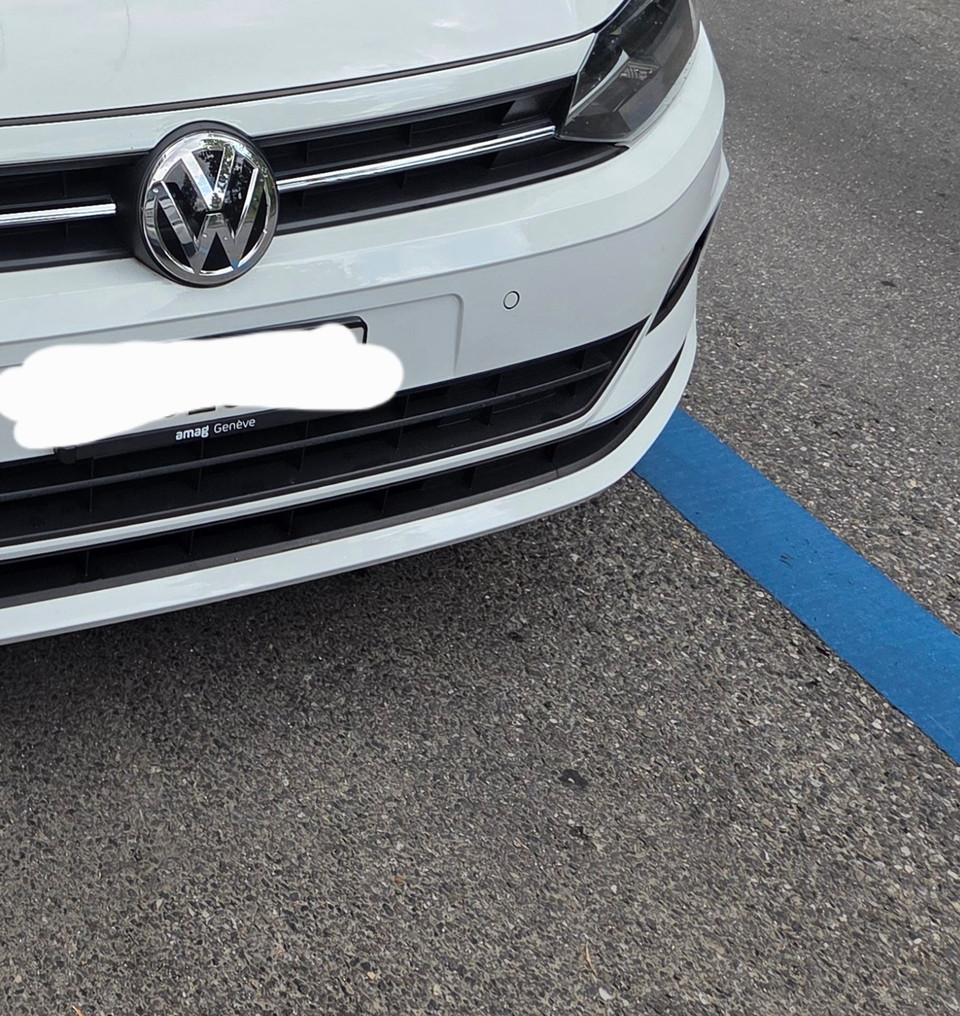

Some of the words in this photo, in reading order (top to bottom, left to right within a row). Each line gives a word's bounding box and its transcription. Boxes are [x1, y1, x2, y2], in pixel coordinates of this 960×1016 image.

[144, 134, 276, 284] VW
[175, 425, 210, 441] amag
[213, 418, 256, 434] Genève
